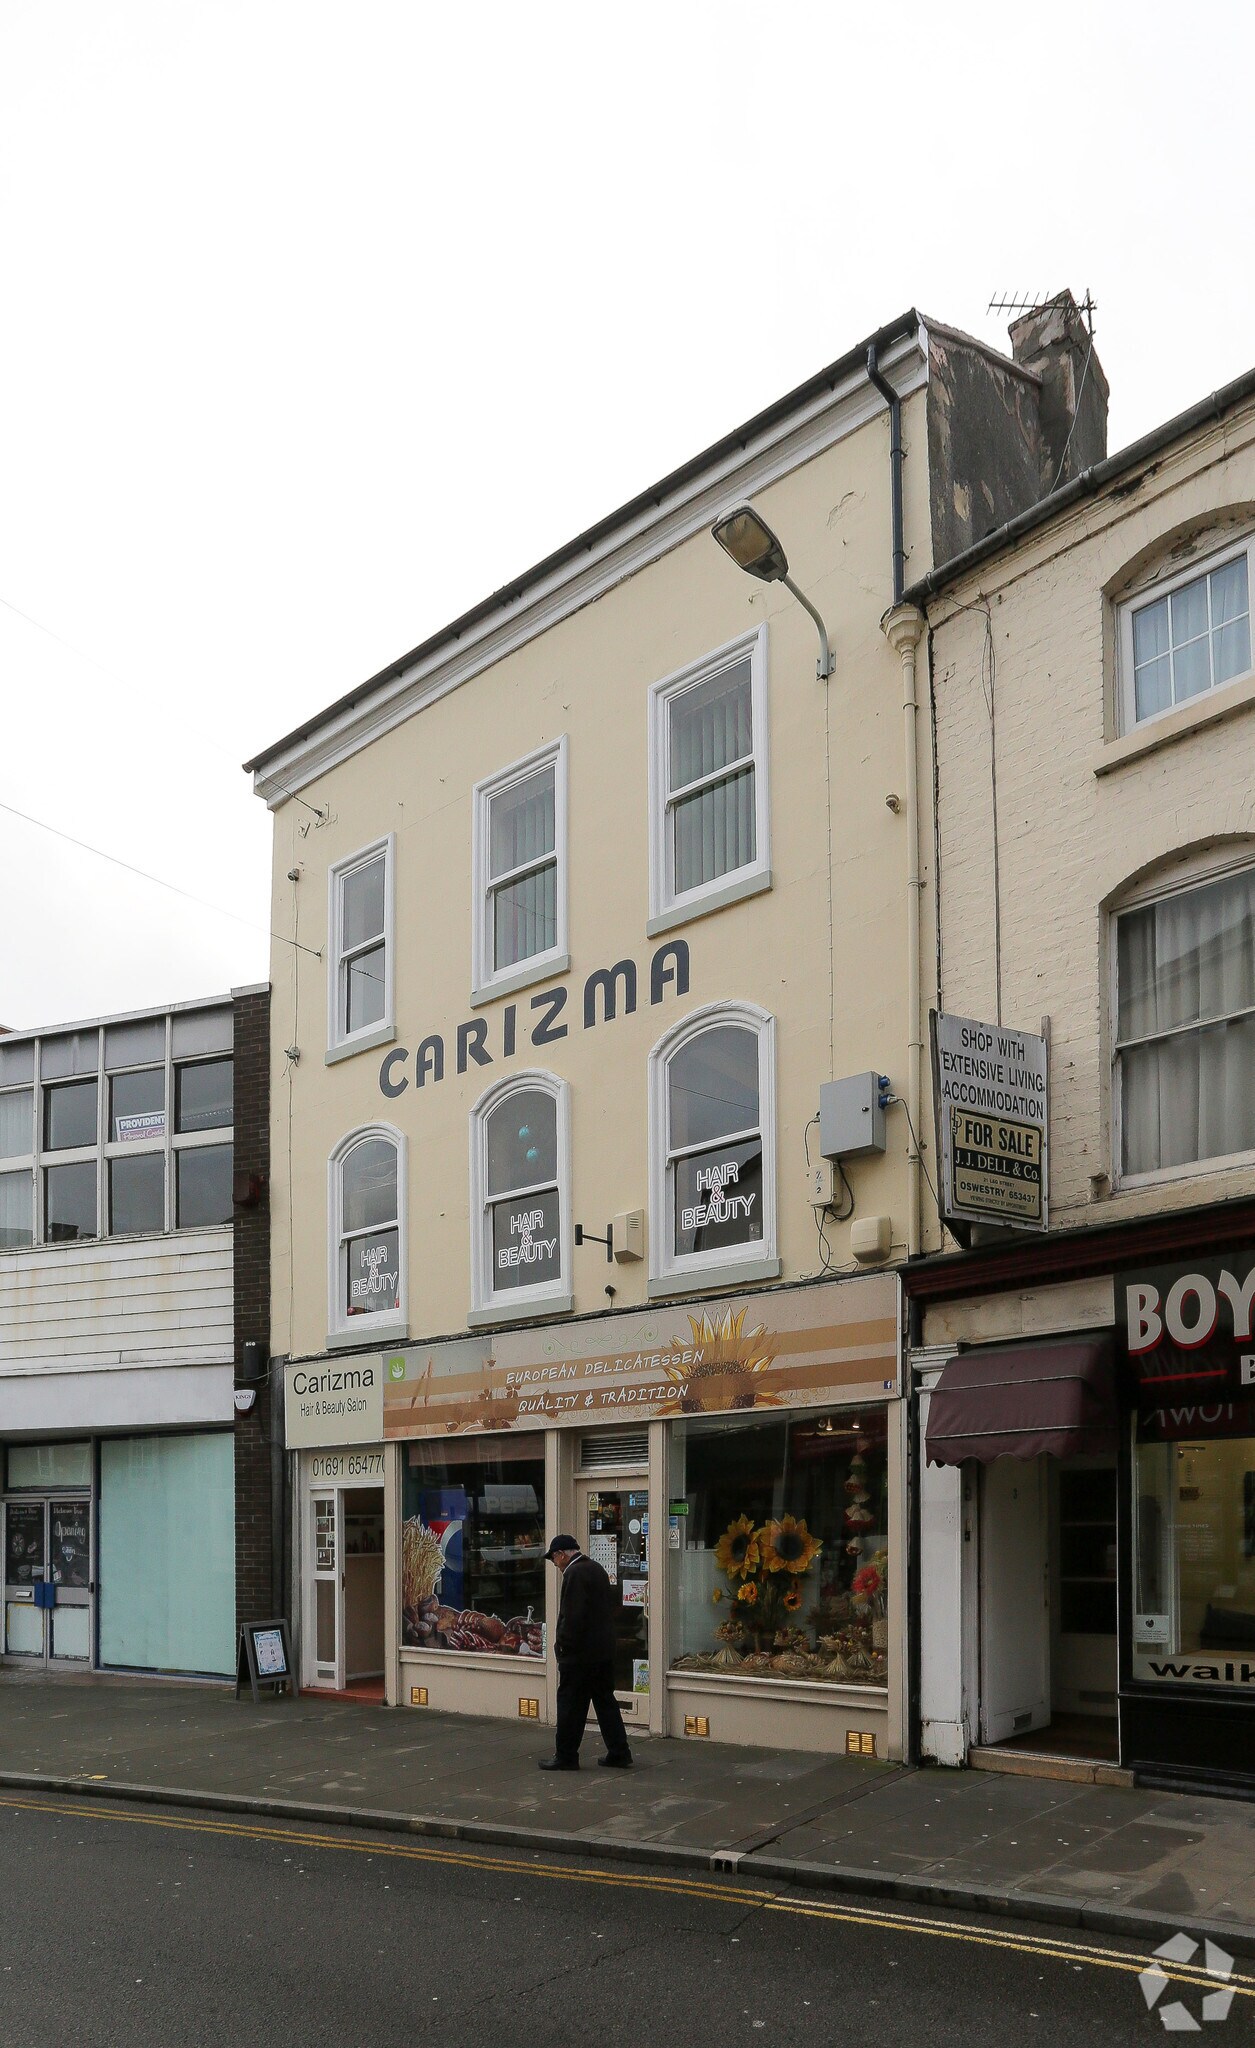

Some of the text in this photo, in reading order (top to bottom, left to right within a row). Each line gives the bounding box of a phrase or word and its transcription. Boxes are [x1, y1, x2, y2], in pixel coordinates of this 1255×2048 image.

[379, 938, 690, 1099] CARIZMA
[961, 1027, 1025, 1061] SHOP WITH
[942, 1051, 1043, 1092] EXTENSIVE LIVING
[943, 1079, 1044, 1119] ACCOMMODATION
[965, 1119, 1034, 1157] FOR SALE
[696, 1161, 739, 1192] HAIR
[977, 1154, 1010, 1174] DELL
[1012, 1161, 1021, 1177] &
[1023, 1164, 1040, 1181] Co.
[710, 1182, 725, 1204] &
[960, 1181, 1036, 1204] OSWESTRY 653437
[510, 1209, 544, 1234] HAIR
[681, 1193, 756, 1230] BEAUTY
[521, 1226, 533, 1246] &
[360, 1245, 388, 1268] HAIR
[498, 1238, 557, 1268] BEAUTY
[369, 1261, 380, 1278] &
[351, 1271, 398, 1298] BEAUTY
[506, 1348, 705, 1385] EUROPEAN DELICATESSEN
[293, 1368, 374, 1395] Carizma
[300, 1397, 367, 1417] Hair & Beauty Salon
[518, 1383, 689, 1413] QUALITY & TRADITION
[312, 1456, 344, 1477] 01691
